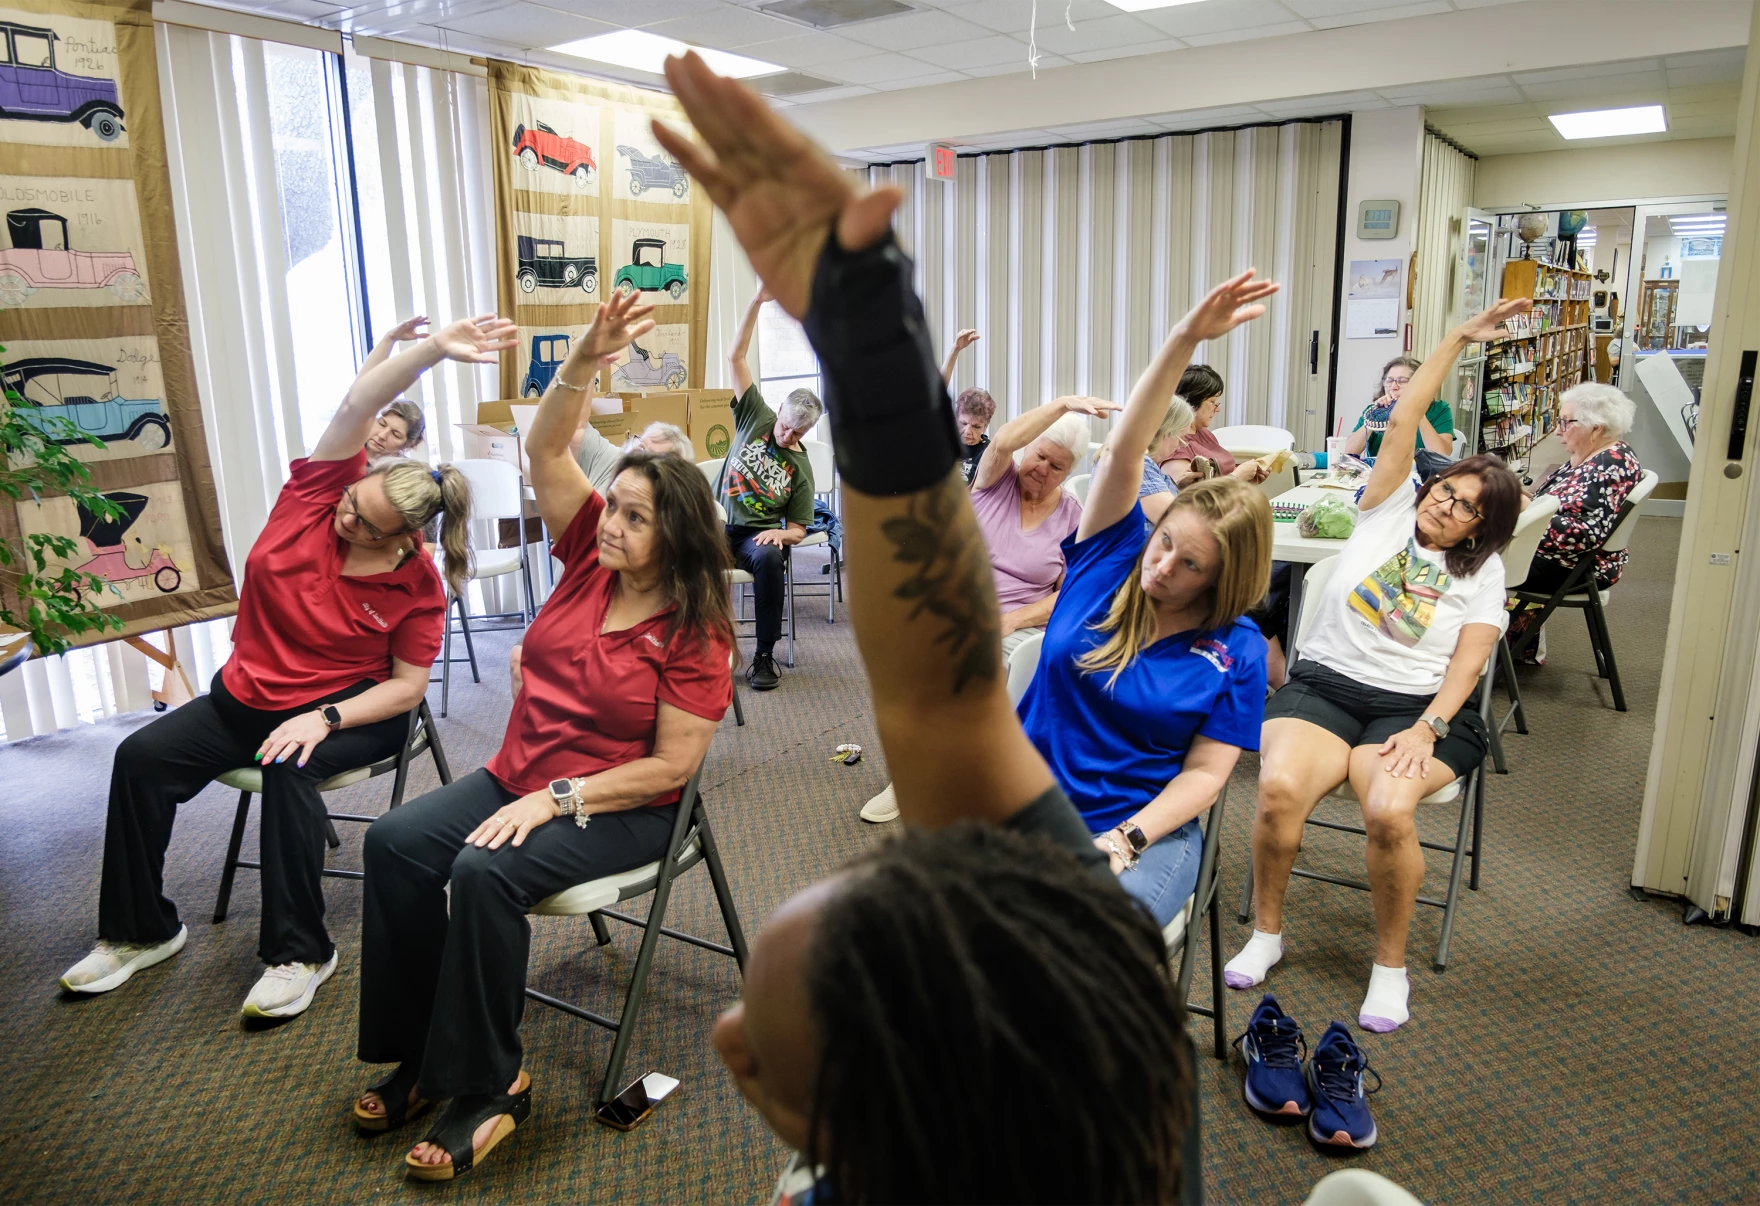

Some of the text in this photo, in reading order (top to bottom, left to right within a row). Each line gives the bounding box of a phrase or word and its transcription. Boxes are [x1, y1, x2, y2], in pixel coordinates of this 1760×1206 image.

[64, 35, 117, 54] Pontiac
[74, 57, 104, 70] 1926
[935, 147, 955, 178] EXIT
[77, 212, 103, 226] 1916
[628, 226, 671, 239] PLYMOUTH
[116, 347, 161, 372] Dodge
[731, 458, 749, 479] STILL
